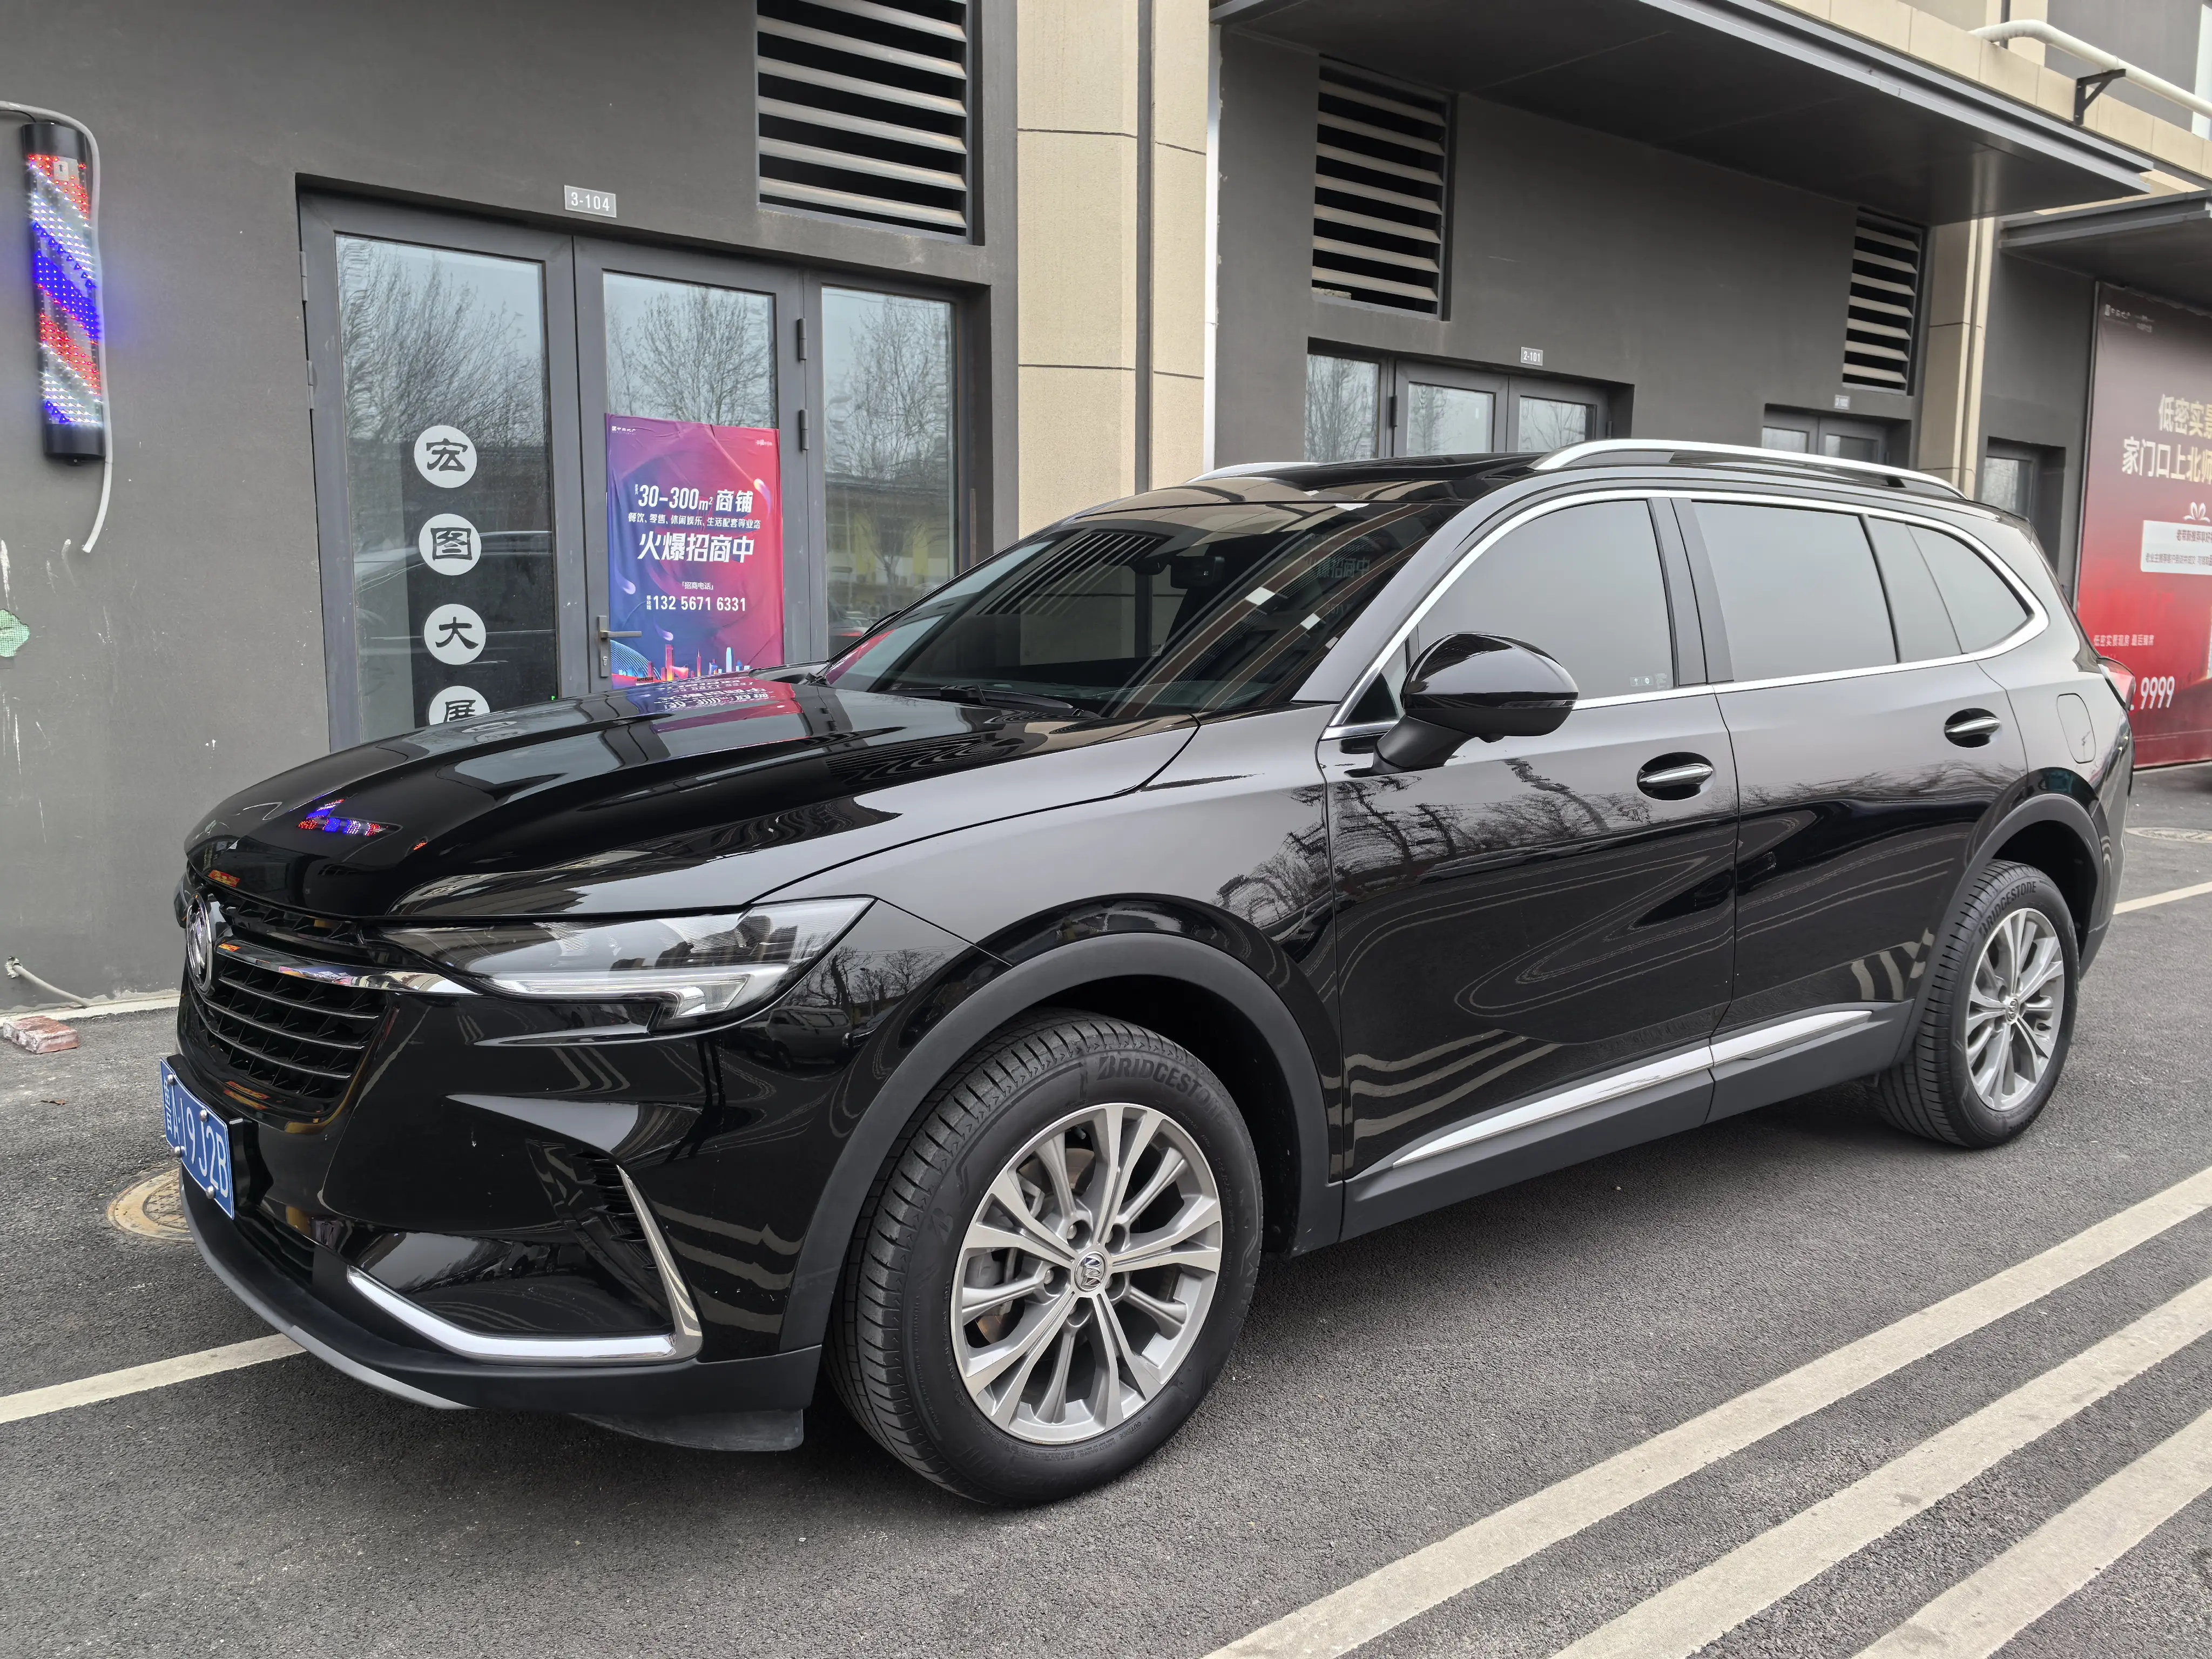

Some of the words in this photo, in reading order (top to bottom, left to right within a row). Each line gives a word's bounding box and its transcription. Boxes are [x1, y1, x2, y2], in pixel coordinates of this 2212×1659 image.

[571, 192, 610, 212] 3-104
[1523, 350, 1541, 362] 2-101
[716, 489, 754, 513] 商铺
[637, 531, 755, 563] 火爆招商中
[653, 595, 676, 610] 132
[681, 596, 711, 611] 5671
[717, 597, 745, 611] 6331
[1978, 881, 2037, 938] BRIDGESTONE
[1096, 1055, 1229, 1127] BRIDGESTONE
